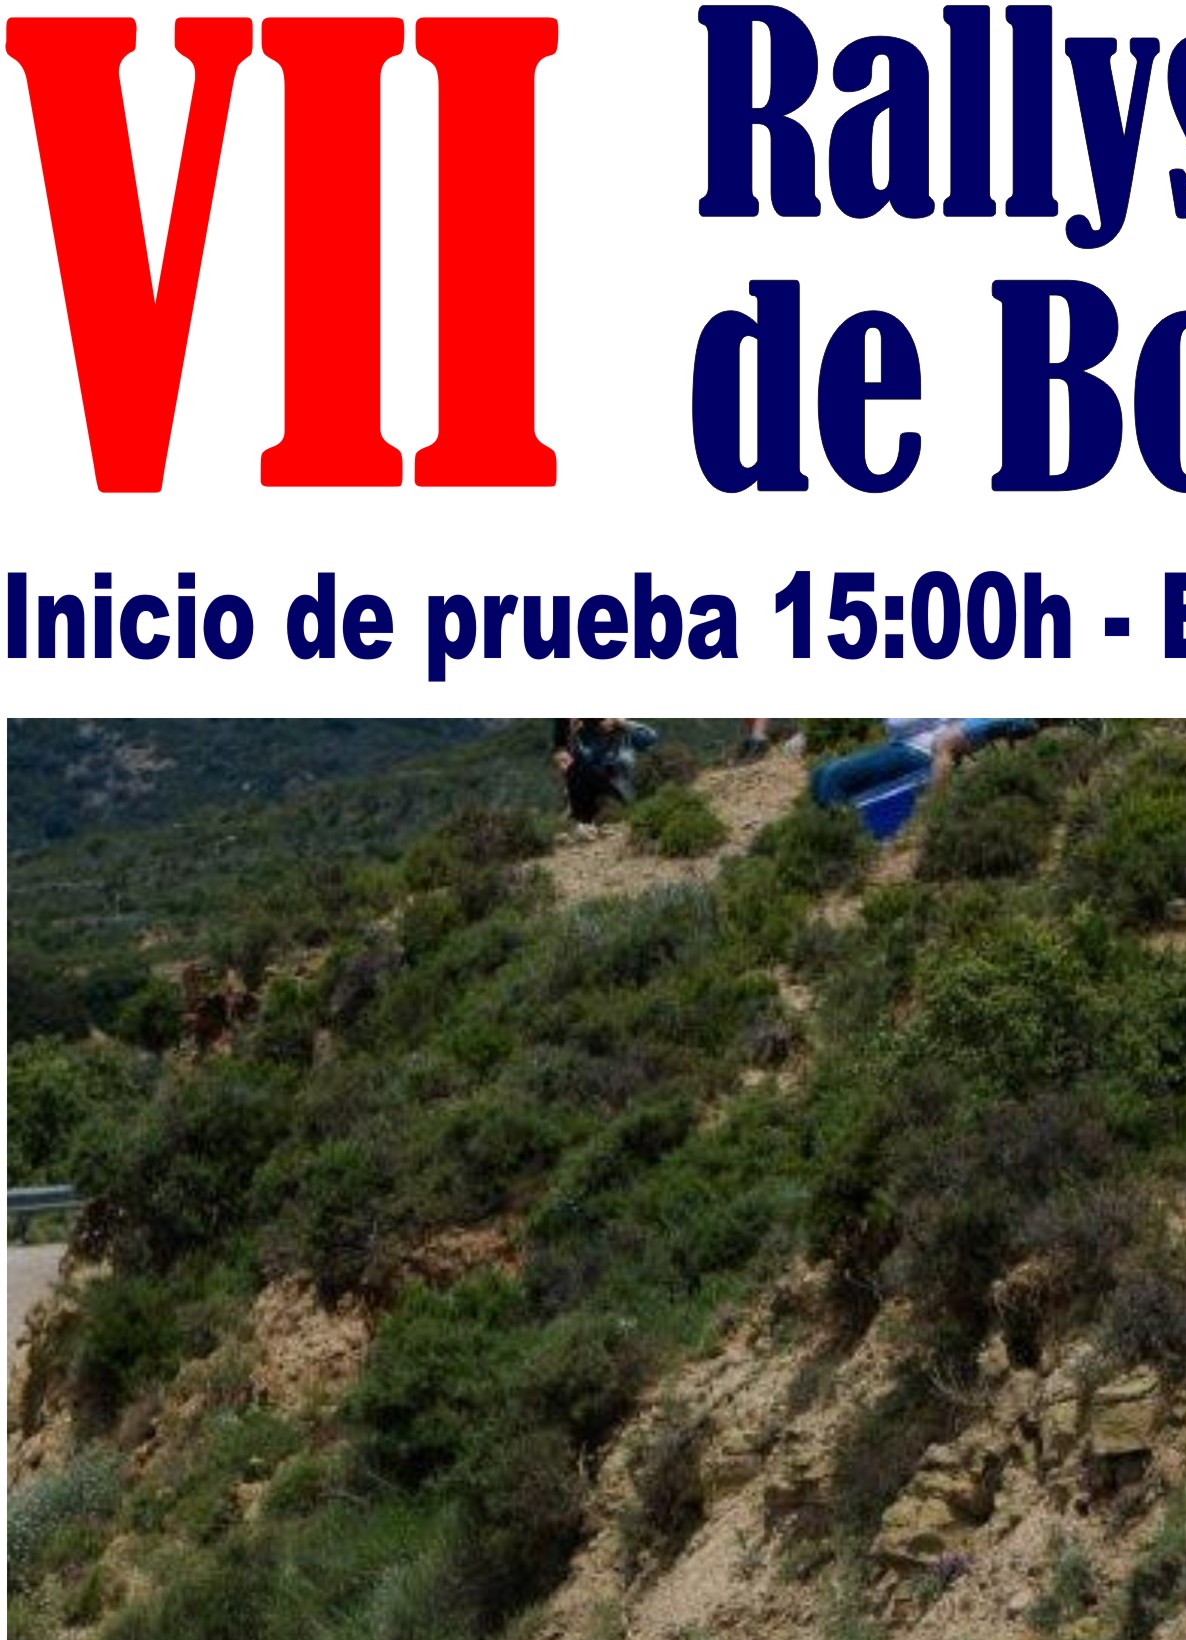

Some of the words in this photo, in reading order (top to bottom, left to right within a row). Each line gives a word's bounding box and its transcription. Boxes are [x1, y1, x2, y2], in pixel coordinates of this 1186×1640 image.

[5, 17, 558, 493] VII
[692, 280, 921, 493] de
[8, 573, 253, 659] Inicio
[287, 573, 393, 659] de
[429, 573, 738, 682] prueba
[776, 571, 1070, 659] 15:00h
